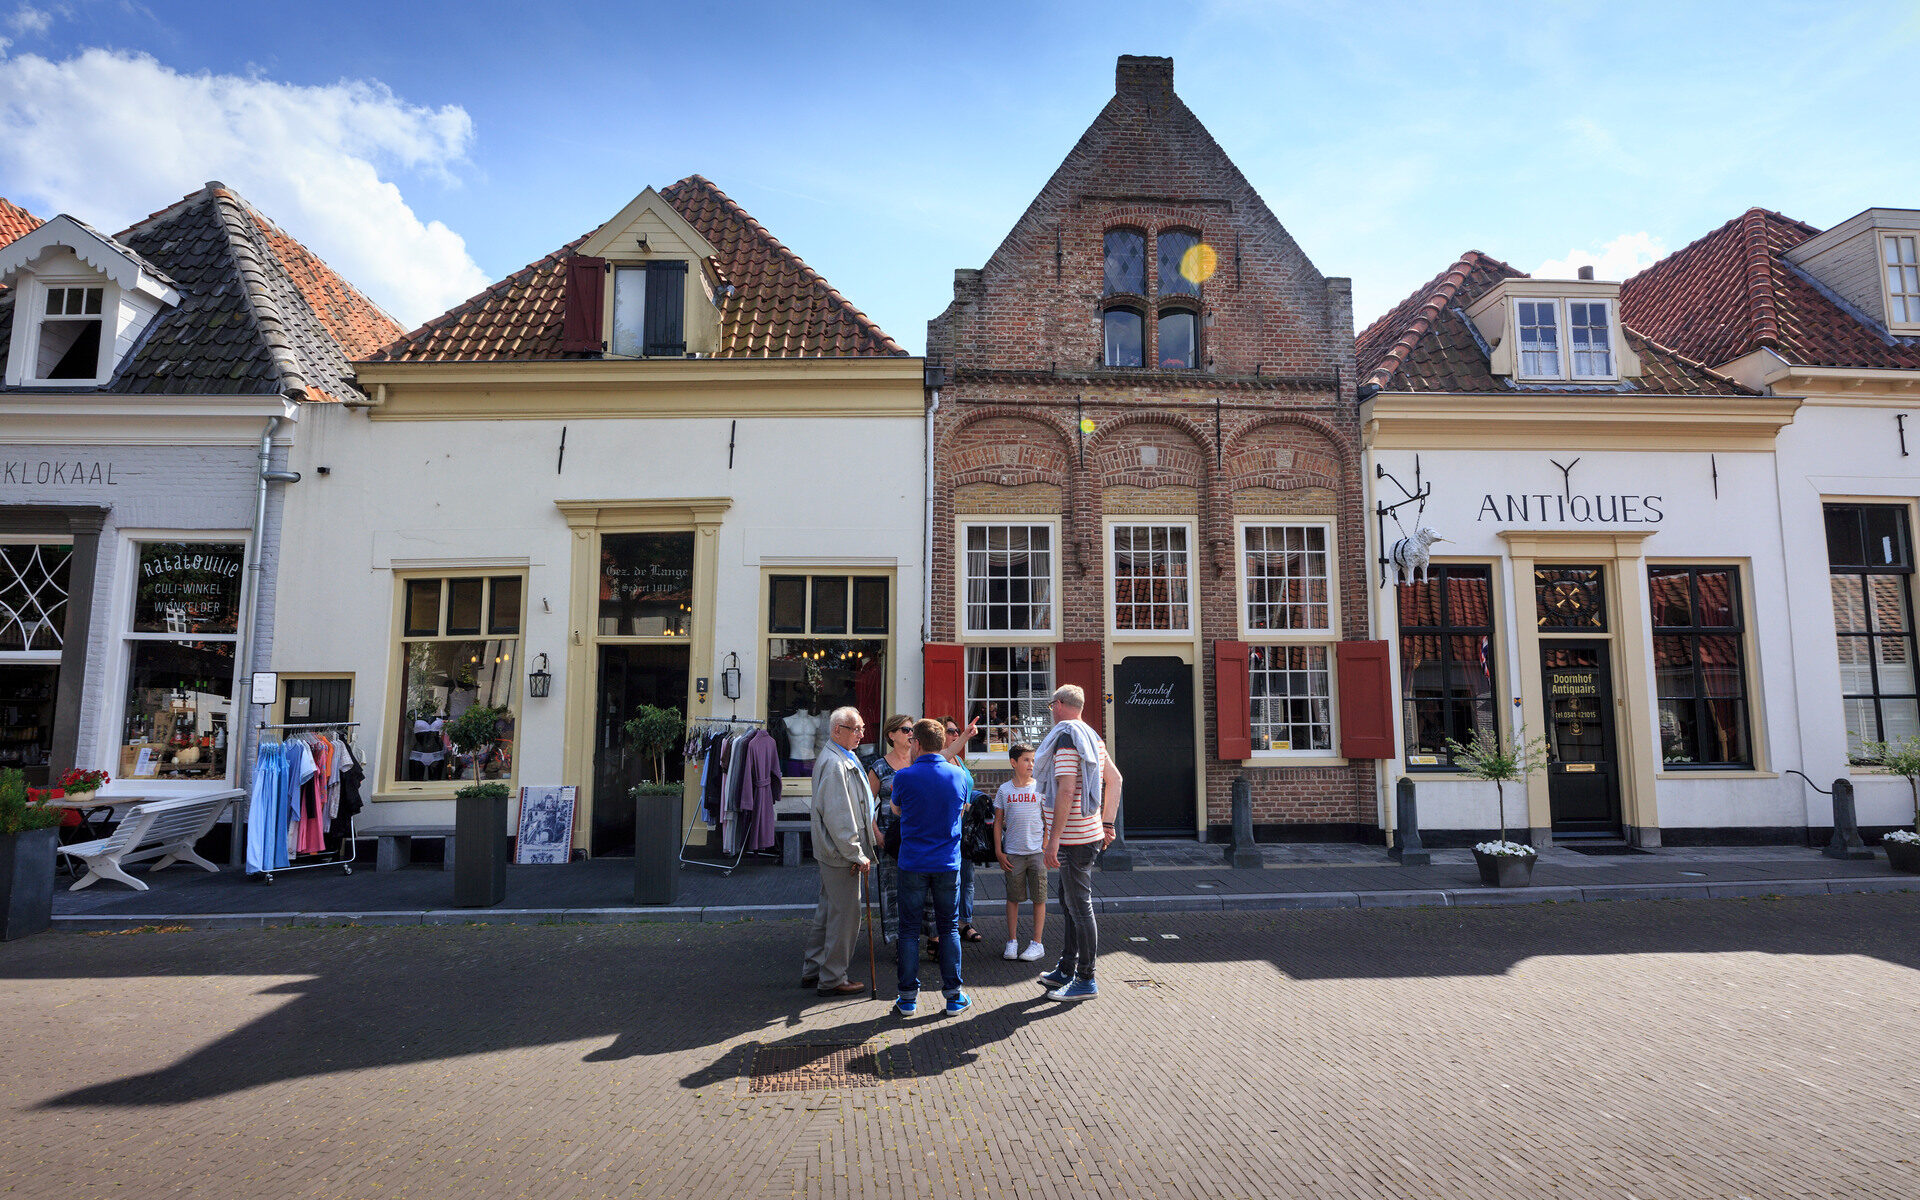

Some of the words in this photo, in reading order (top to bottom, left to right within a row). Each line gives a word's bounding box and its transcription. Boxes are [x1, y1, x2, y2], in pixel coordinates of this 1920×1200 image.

[4, 461, 118, 485] KLOKAAL
[1477, 494, 1664, 523] ANTIQUES
[634, 566, 647, 576] de
[649, 564, 688, 580] Lange
[154, 583, 222, 595] CULI-WINKEL
[1553, 673, 1592, 684] Doornhof
[1552, 684, 1596, 695] Antiquairs
[1006, 793, 1037, 804] ALOHA
